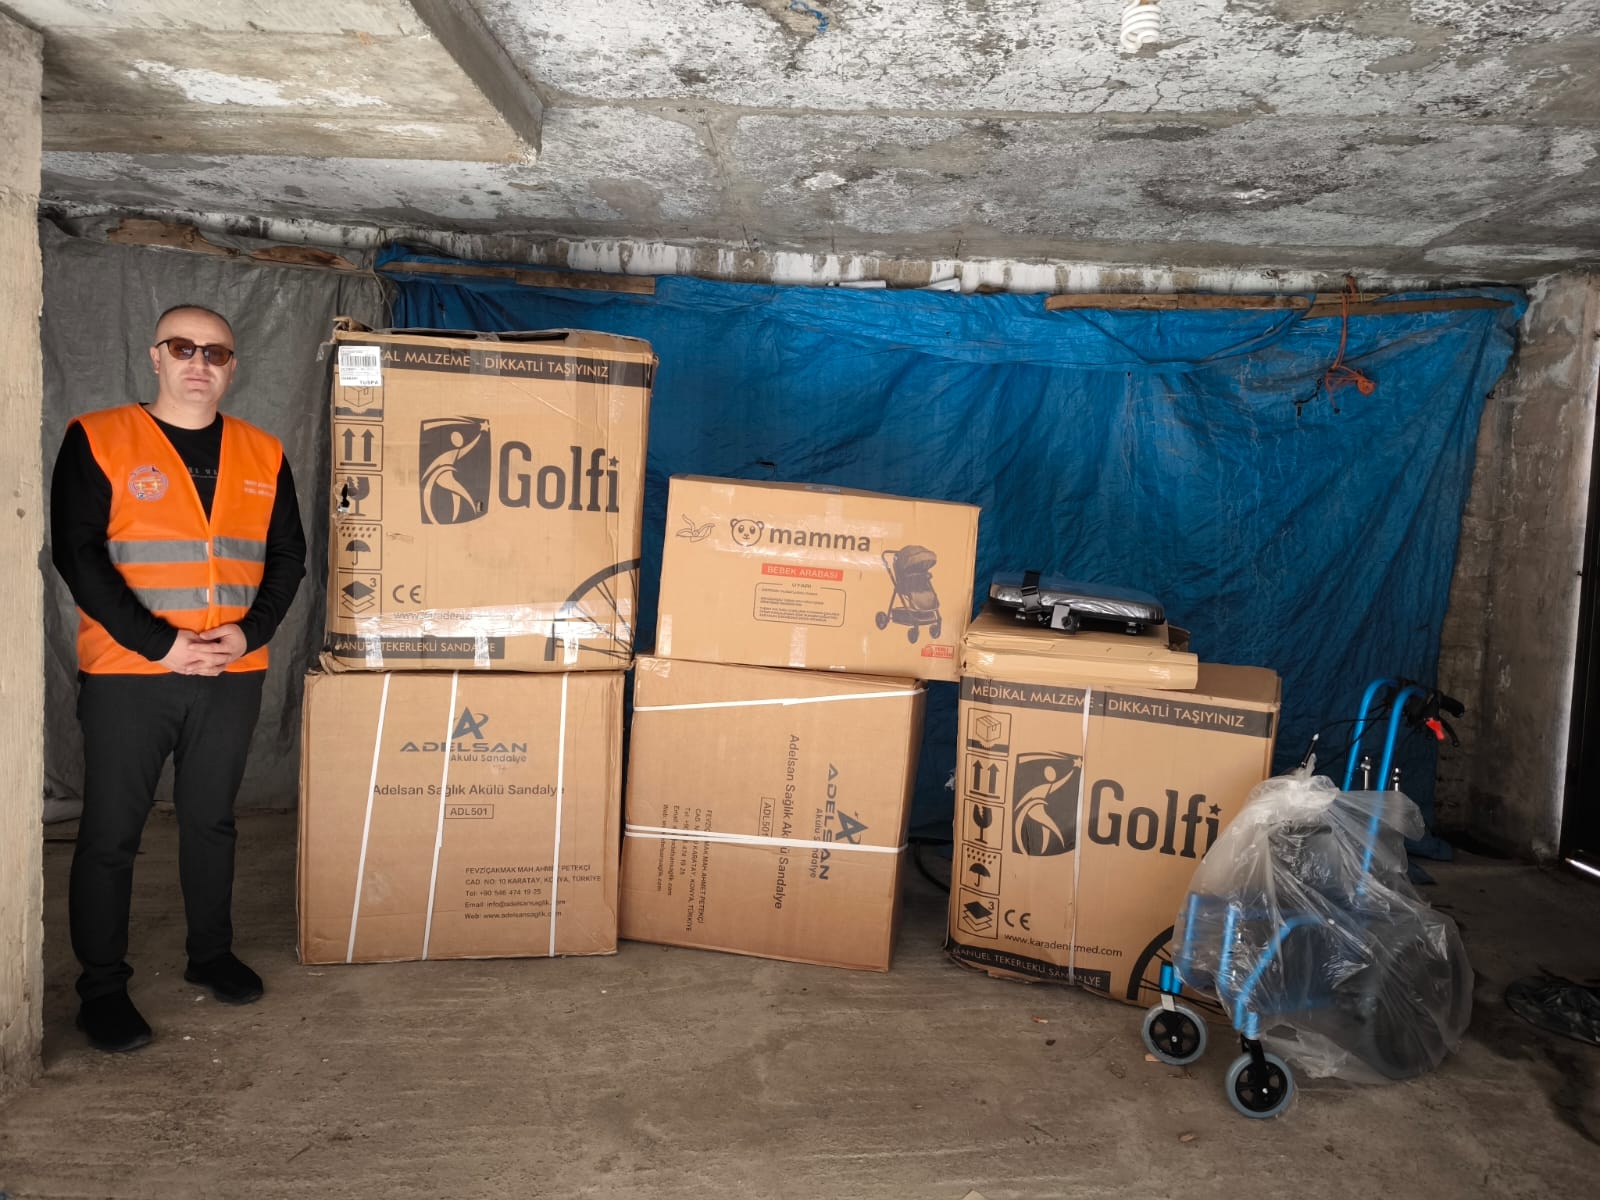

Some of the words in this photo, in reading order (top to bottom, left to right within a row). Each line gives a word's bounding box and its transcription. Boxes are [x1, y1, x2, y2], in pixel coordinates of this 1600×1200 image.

[404, 352, 470, 367] MALZEME
[485, 357, 543, 373] DİKKATLİ
[549, 361, 609, 379] TAŞIYINIZ
[498, 441, 619, 513] Golfi
[769, 527, 871, 552] mamma
[767, 565, 798, 575] BEBEK
[370, 578, 377, 587] 3
[381, 640, 437, 652] TEKERLEKLİ
[971, 683, 1027, 702] MEDİKAL
[1108, 698, 1170, 718] DİKKATLİ
[1174, 706, 1245, 728] TAŞIYINIZ
[400, 741, 527, 753] ADELSAN
[481, 755, 527, 764] Sandalye
[786, 734, 800, 781] Adelsan
[374, 785, 424, 796] Adelsan
[469, 783, 504, 795] Akülü
[782, 784, 796, 819] Sağlık
[450, 807, 488, 816] ADL501
[1088, 778, 1222, 860] Golfi
[773, 857, 788, 910] Sandalye
[988, 901, 995, 911] 3
